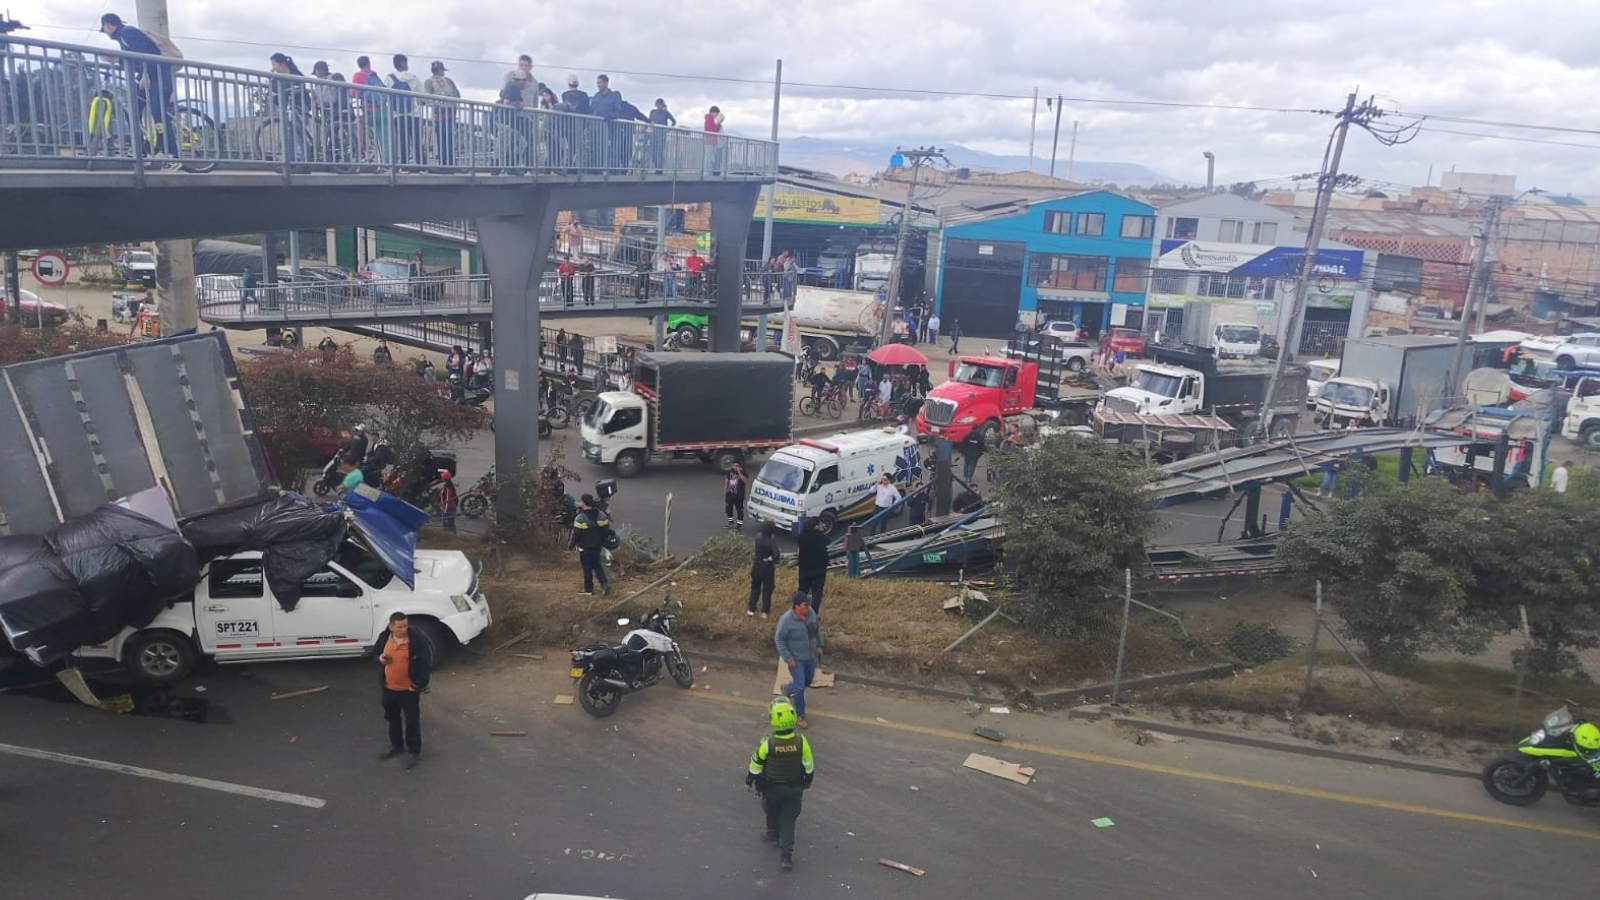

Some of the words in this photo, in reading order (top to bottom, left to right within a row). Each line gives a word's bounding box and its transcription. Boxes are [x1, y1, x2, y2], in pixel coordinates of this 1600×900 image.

[217, 622, 236, 633] SPT
[238, 621, 258, 632] 221
[775, 744, 798, 753] POLICIA
